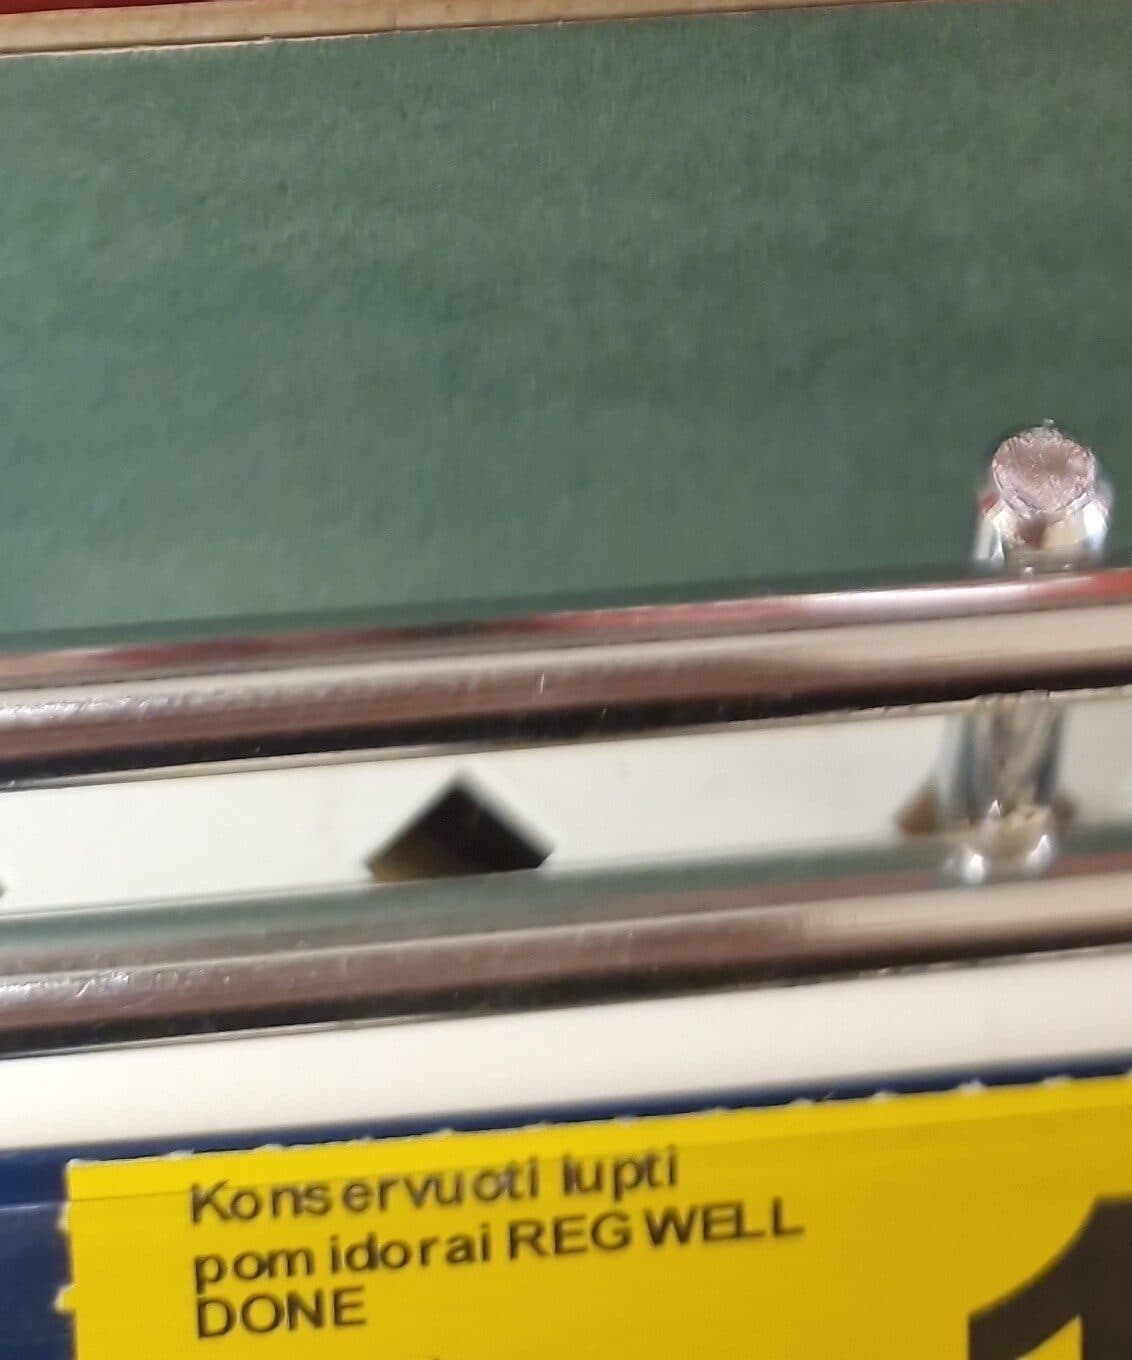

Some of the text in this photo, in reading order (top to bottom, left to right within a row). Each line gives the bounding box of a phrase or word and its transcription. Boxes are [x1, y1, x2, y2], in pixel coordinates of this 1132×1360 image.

[190, 1144, 678, 1225] Konservuoti lupti
[193, 1197, 806, 1292] pomidorai REG WELL
[196, 1286, 367, 1340] DONE
